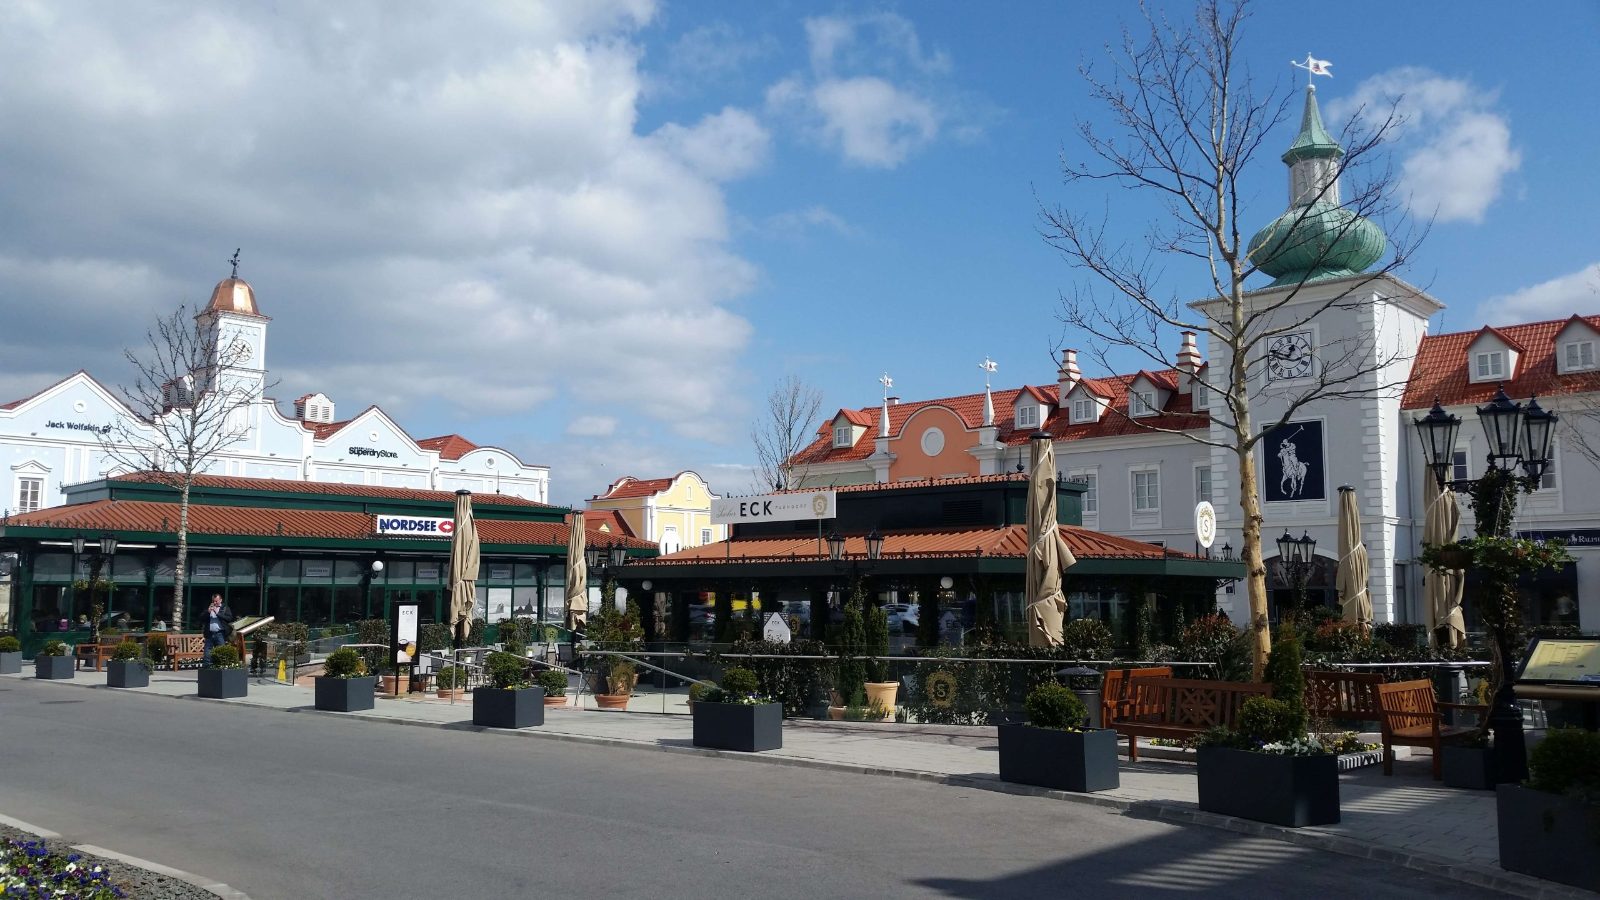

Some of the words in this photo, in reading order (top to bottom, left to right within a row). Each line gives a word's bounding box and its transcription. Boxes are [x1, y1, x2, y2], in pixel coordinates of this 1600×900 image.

[45, 420, 65, 430] Jack
[66, 421, 100, 432] Wolfskin
[740, 501, 773, 517] ECK
[379, 518, 437, 532] NORDSEE
[1203, 519, 1209, 533] S
[936, 683, 946, 698] S
